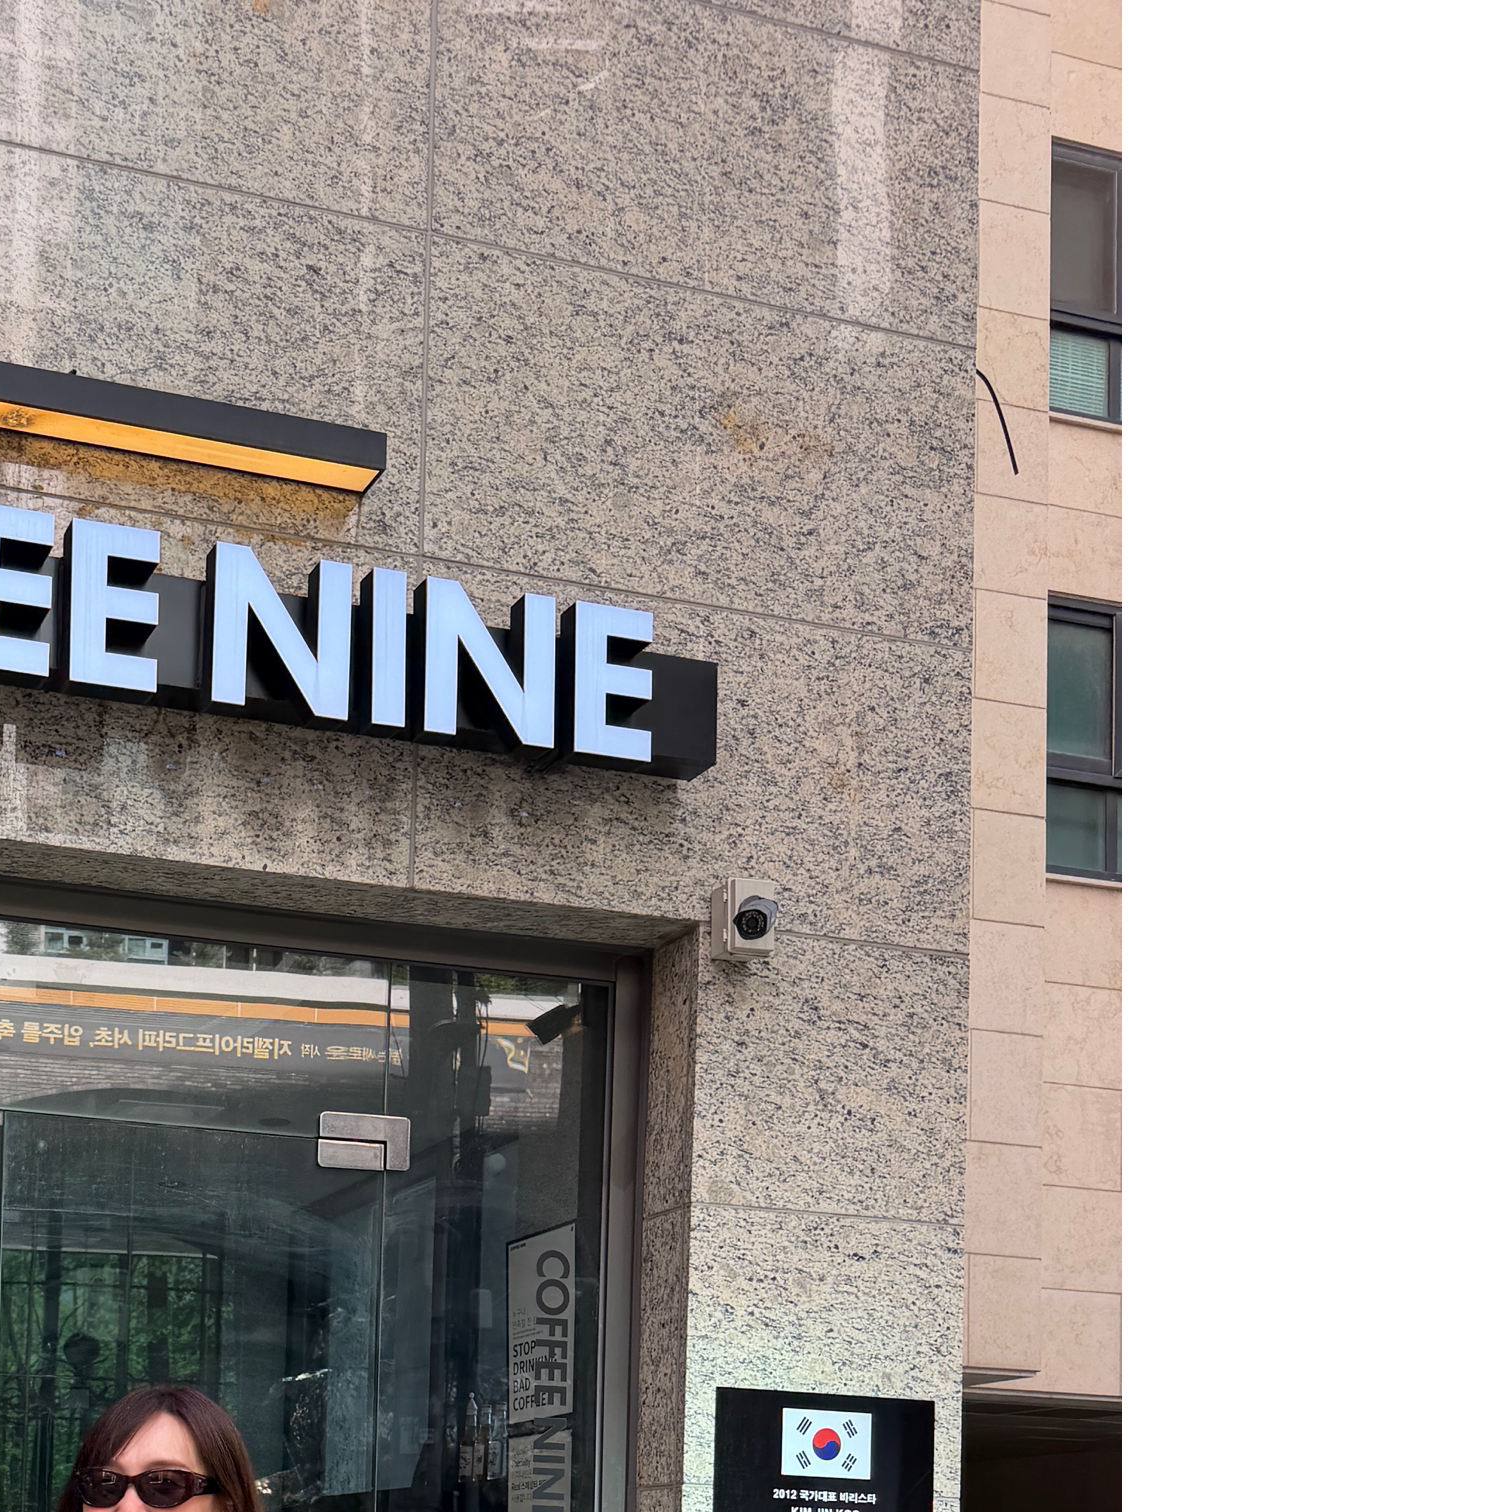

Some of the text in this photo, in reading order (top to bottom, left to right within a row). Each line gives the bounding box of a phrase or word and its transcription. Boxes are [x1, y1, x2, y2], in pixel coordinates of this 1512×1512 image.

[210, 540, 655, 763] NINE
[534, 1250, 571, 1407] COFFEE
[513, 1339, 536, 1358] STOP
[513, 1353, 558, 1376] DRIN
[513, 1377, 531, 1393] BAD
[513, 1391, 546, 1411] COFFE
[772, 1488, 797, 1500] 2012
[799, 1490, 837, 1502] 국가대표
